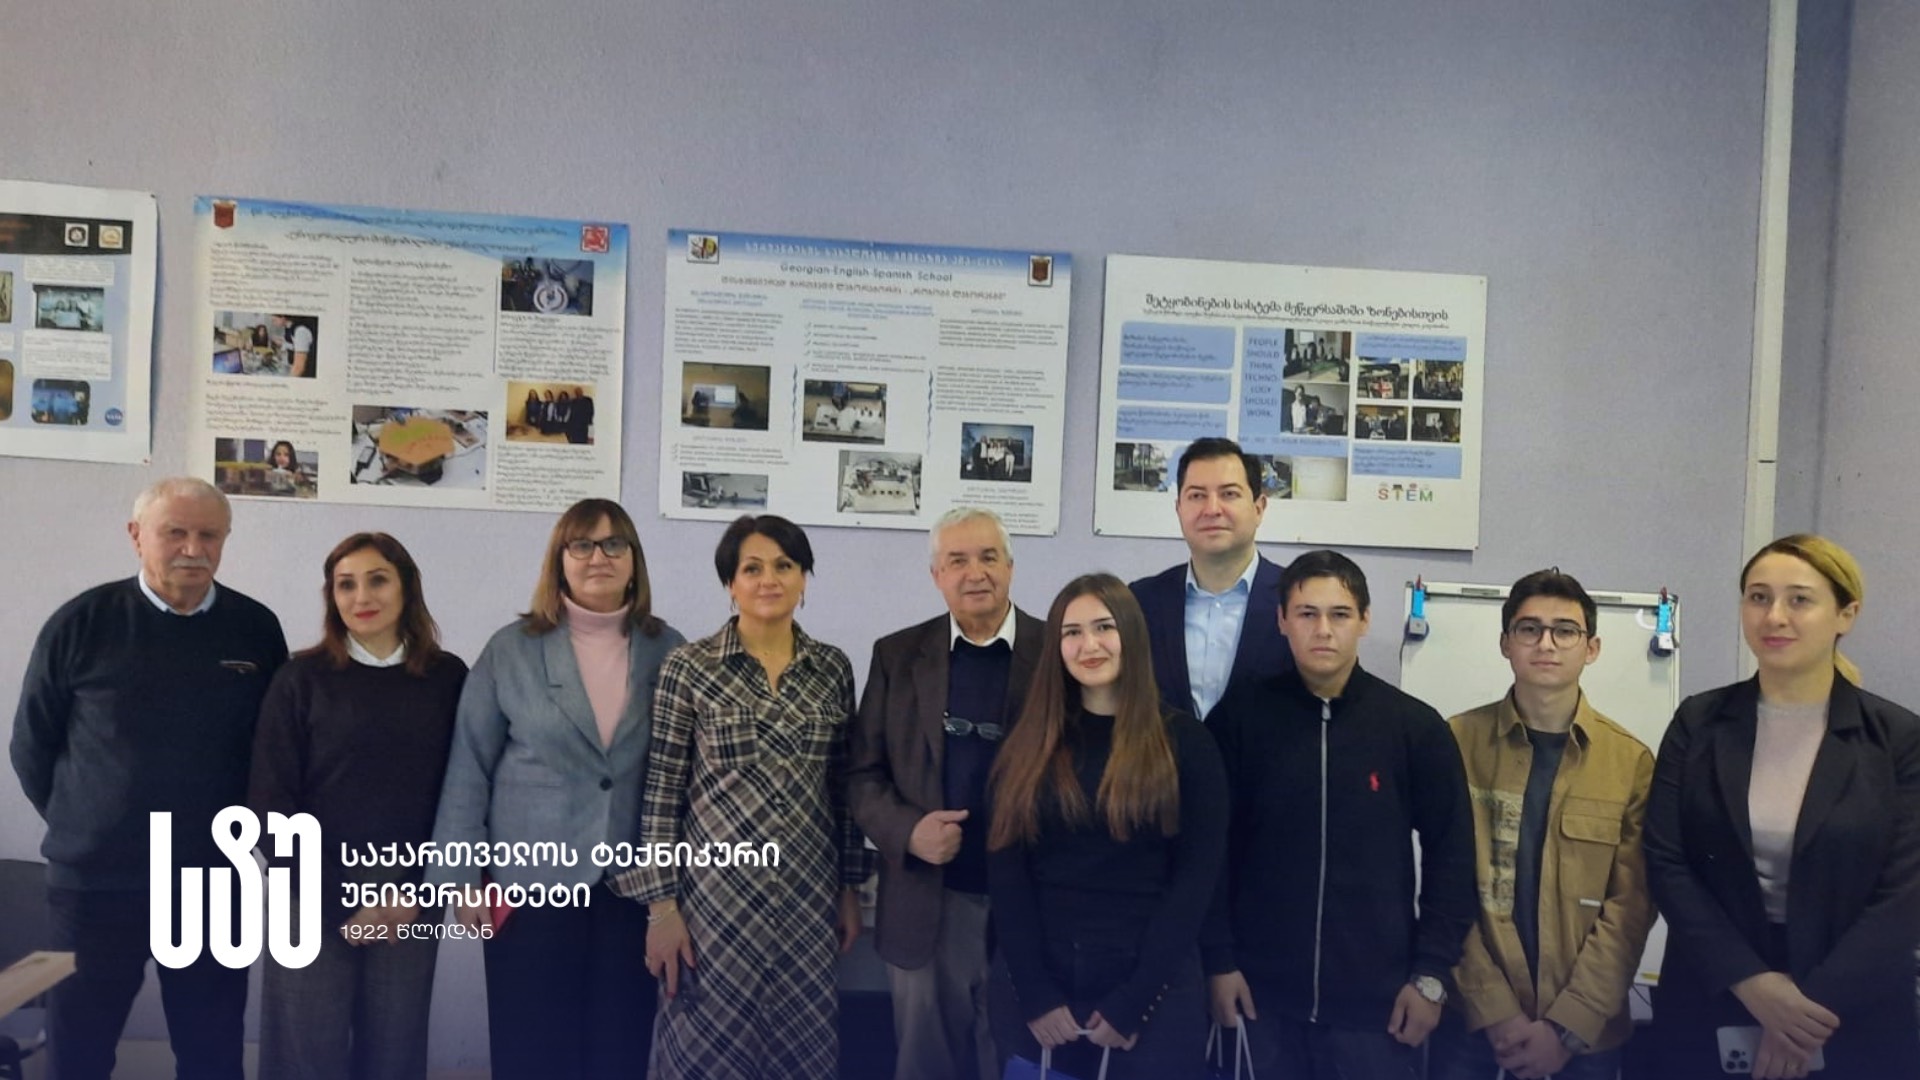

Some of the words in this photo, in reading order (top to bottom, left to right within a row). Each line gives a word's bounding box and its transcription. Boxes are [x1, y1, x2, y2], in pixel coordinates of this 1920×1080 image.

[918, 270, 952, 281] School
[1233, 298, 1281, 314] სისტემა
[1378, 486, 1433, 502] STEM
